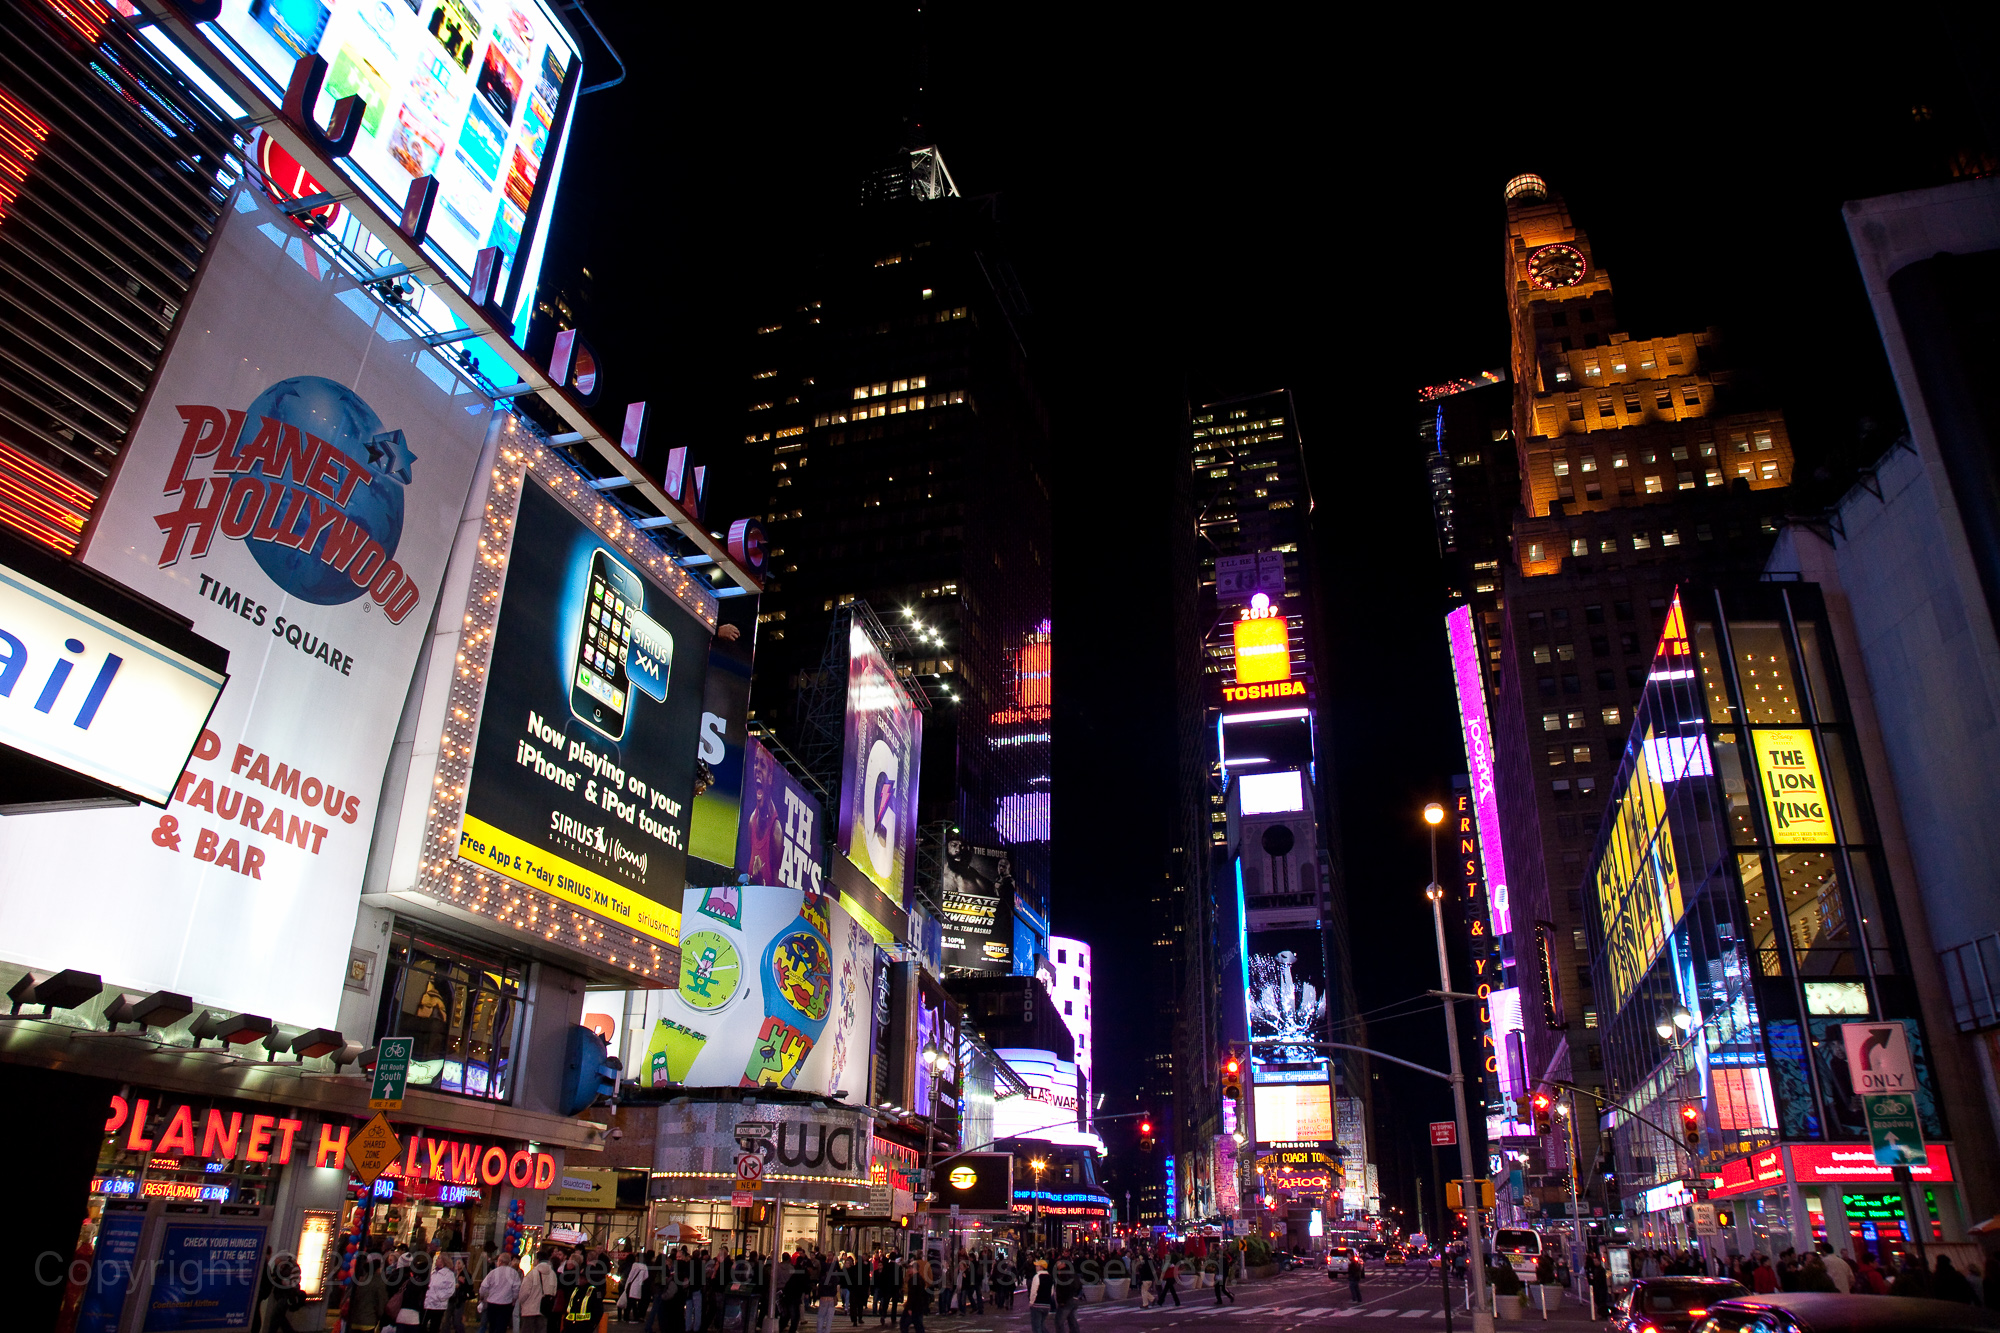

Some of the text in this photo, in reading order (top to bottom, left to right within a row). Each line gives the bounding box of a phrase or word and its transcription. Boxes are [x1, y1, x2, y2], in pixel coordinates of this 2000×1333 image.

[163, 404, 373, 508] PLANET
[153, 477, 421, 625] HOLLYWOOD
[1239, 557, 1252, 565] BE
[1255, 555, 1279, 564] ACK
[1241, 606, 1279, 620] 2009
[199, 573, 354, 677] TIMES SQUARE
[634, 627, 668, 664] SIRIUS
[1238, 643, 1285, 656] TOSHIBA
[635, 649, 660, 681] XM
[1223, 681, 1305, 701] TOSHIBA
[527, 710, 682, 818] Now playing on your
[1769, 750, 1804, 765] THE
[231, 743, 361, 825] FAMOUS
[1767, 771, 1816, 797] LION
[584, 779, 598, 805] &
[602, 787, 635, 824] iPod
[864, 739, 899, 879] G
[785, 786, 813, 854] TH
[1773, 801, 1824, 828] KING
[550, 811, 594, 848] SIRIUS
[151, 814, 266, 881] & BAR
[973, 846, 1008, 859] THE HOUSE
[549, 833, 646, 884] SATELLITE RADIO
[460, 833, 485, 854] Free
[489, 846, 511, 867] App
[513, 855, 522, 871] &
[526, 861, 554, 887] 7-day
[611, 898, 630, 918] Trial
[779, 840, 822, 895] AT'S
[961, 925, 973, 933] TEAM
[1459, 796, 1497, 1073] ERNST & YOUNG
[947, 937, 965, 945] 10PM
[983, 945, 1009, 953] SPIKE
[1023, 977, 1033, 1022] 1500
[380, 1072, 402, 1081] South
[1285, 1072, 1327, 1081] Corporation
[1862, 1074, 1904, 1088] ONLY
[1873, 1121, 1914, 1129] Broadway
[105, 1095, 556, 1191] PLANET HLYWOOD
[363, 1140, 386, 1149] SHARED
[1270, 1140, 1319, 1148] Panasonic
[1547, 1128, 1557, 1168] BENVENU
[365, 1151, 380, 1159] ZONE
[1282, 1153, 1308, 1163] COACH
[361, 1161, 380, 1169] AHEAD
[104, 1180, 112, 1192] &
[114, 1180, 135, 1193] BAR
[145, 1183, 230, 1200] RESTAURANT & BAR
[374, 1180, 394, 1198] BAR
[563, 1179, 586, 1190] swatch
[441, 1186, 448, 1201] &
[449, 1186, 466, 1203] BAR
[1014, 1190, 1030, 1199] SHIP
[1068, 1207, 1085, 1215] HURT
[183, 1237, 257, 1248] CHECK YOUR HUNGER
[210, 1250, 256, 1260] AT THE GATE.
[152, 1299, 220, 1309] Continental Airlines
